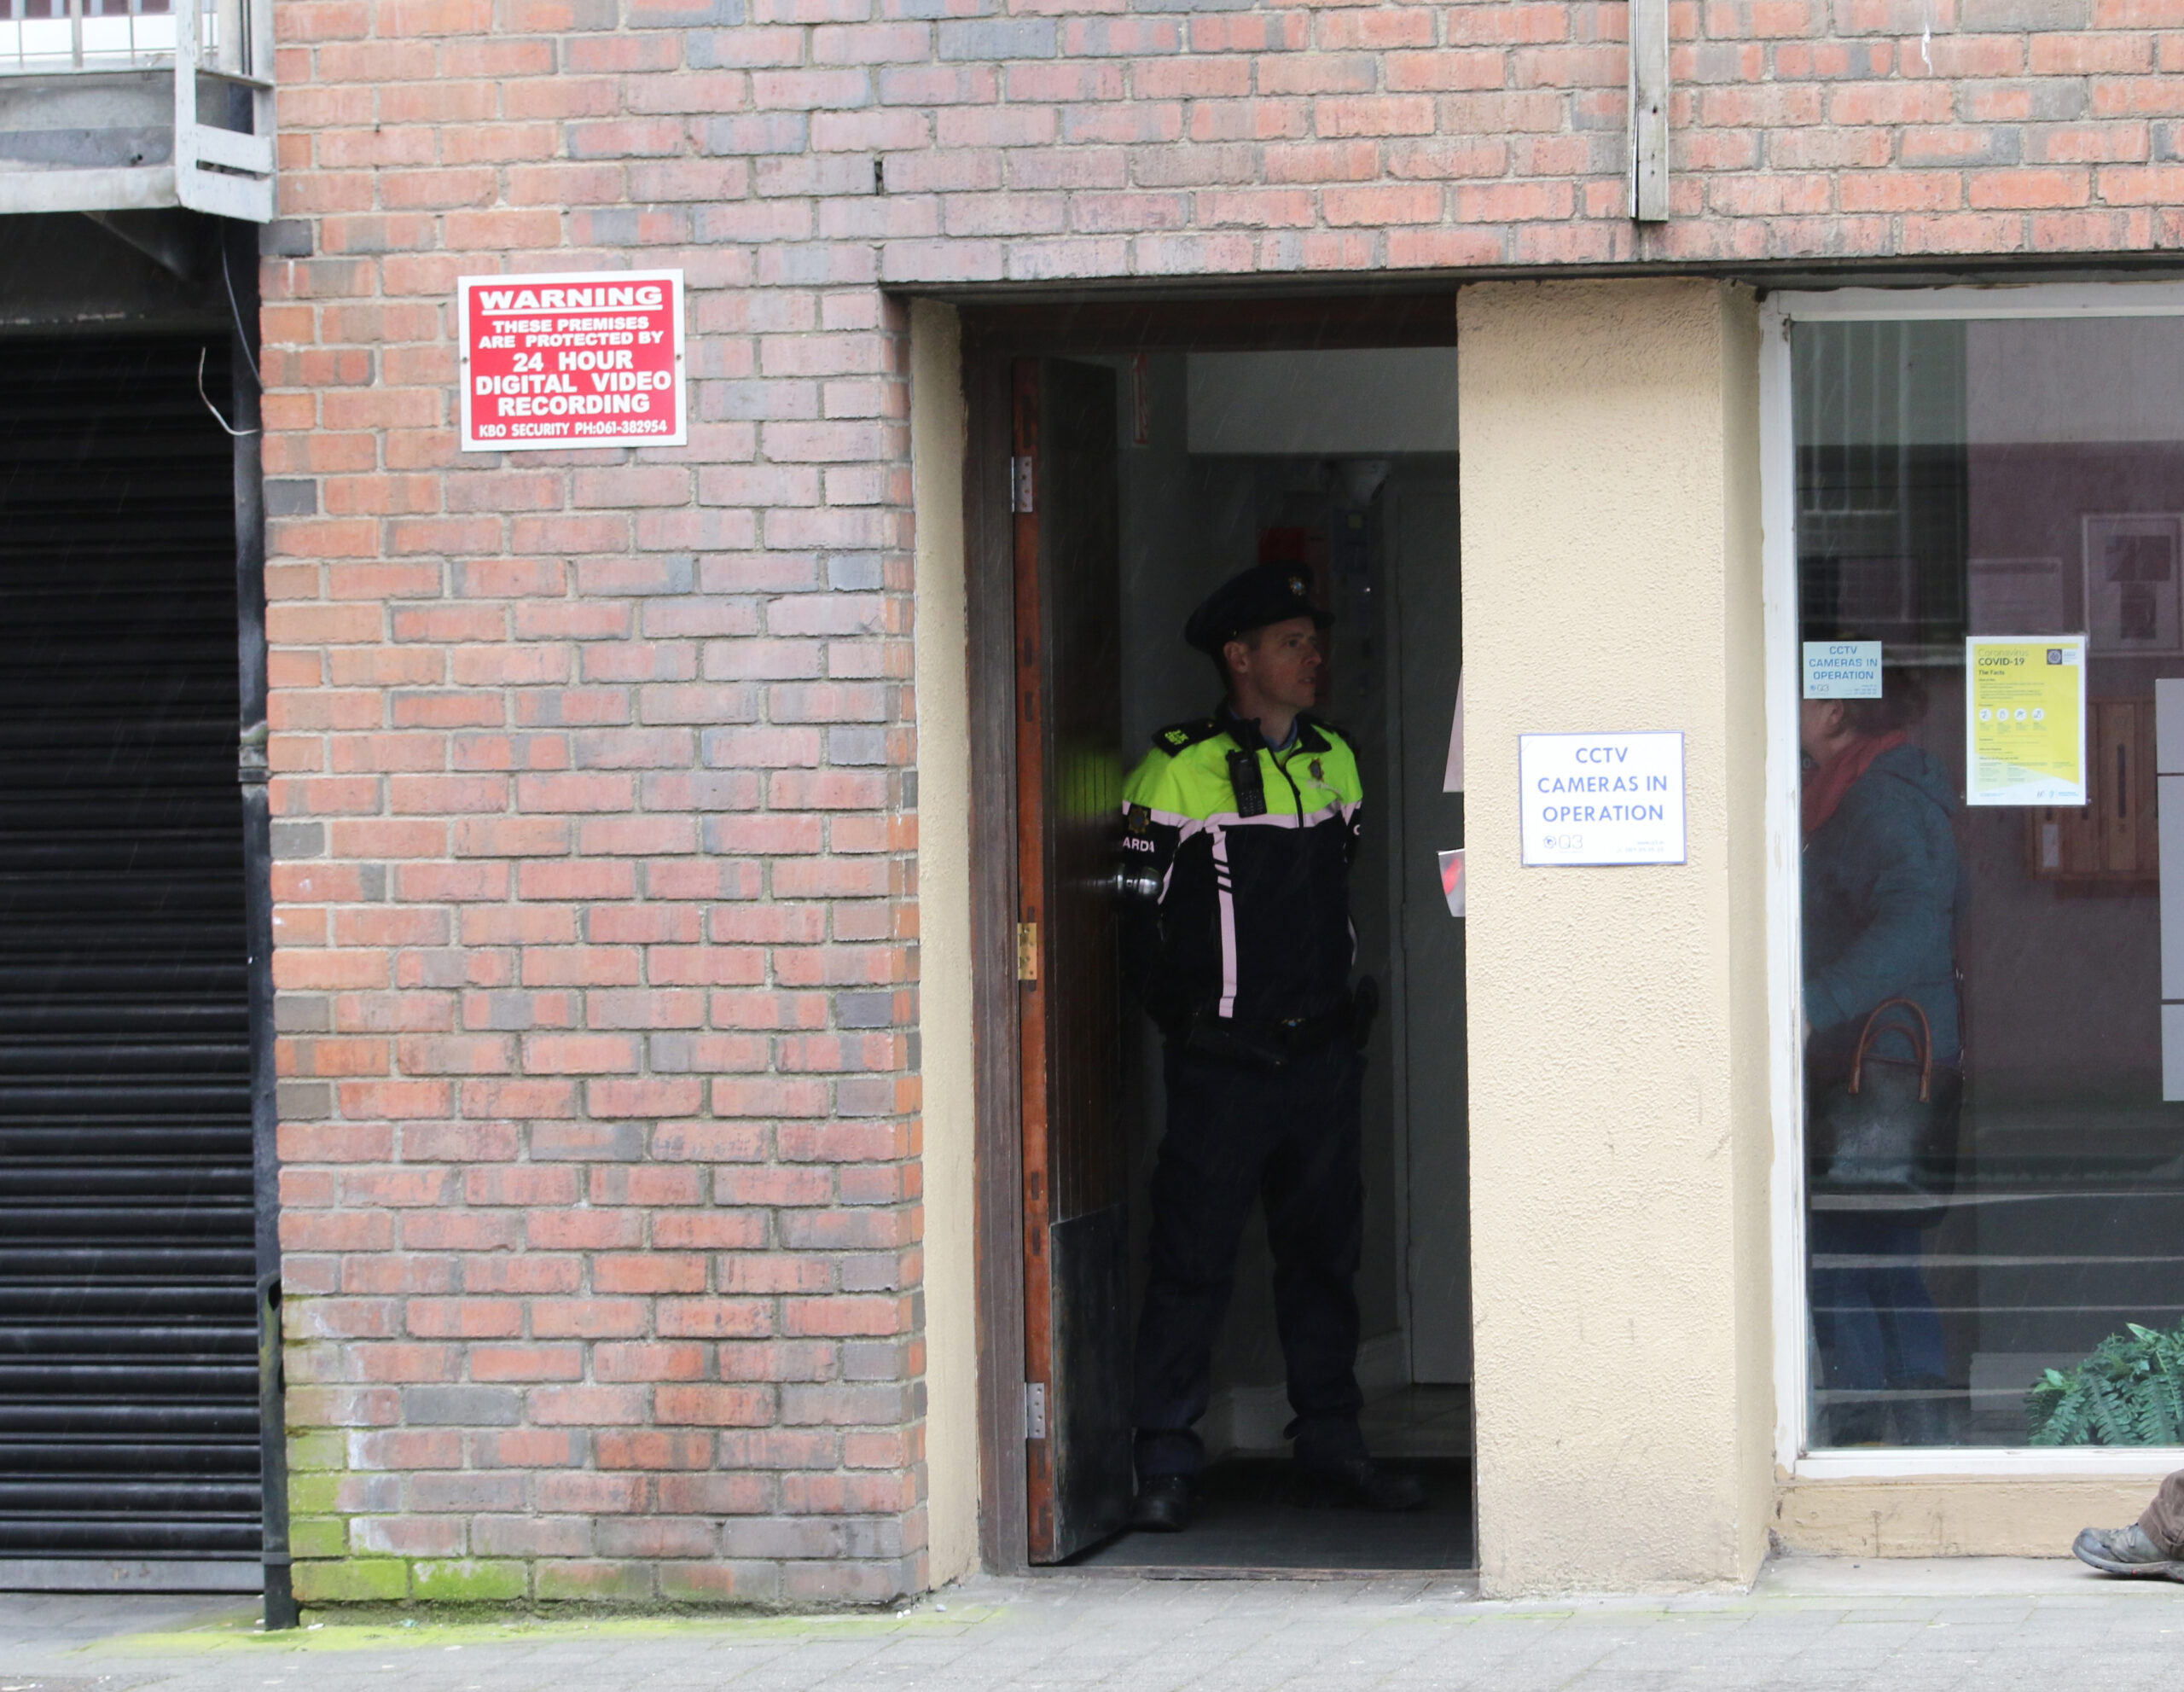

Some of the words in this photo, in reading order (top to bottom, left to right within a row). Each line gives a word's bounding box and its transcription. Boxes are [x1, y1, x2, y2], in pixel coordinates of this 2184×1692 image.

[479, 286, 663, 310] WARNING
[492, 319, 553, 334] THESE
[557, 317, 649, 332] PREMISES
[479, 335, 515, 349] ARE
[526, 332, 634, 347] PROTECTED
[638, 331, 664, 344] BY
[513, 352, 543, 372] 24
[559, 350, 633, 370] HOUR
[476, 374, 578, 395] DIGITAL
[591, 370, 671, 392] VIDEO
[498, 393, 650, 416] RECORDING
[479, 424, 506, 437] KBO
[512, 422, 570, 437] SECURITY
[575, 420, 667, 435] PH:061-382954
[1829, 646, 1857, 654] CCTV
[1809, 659, 1862, 667] CAMERAS
[1978, 657, 2024, 666] COVID-19
[1813, 671, 1873, 680] OPERATION
[1575, 747, 1628, 764] CCTV
[1537, 776, 1639, 794] CAMERAS
[1647, 776, 1667, 792] IN
[1542, 805, 1663, 823] OPERATION
[1122, 836, 1155, 853] ARDA
